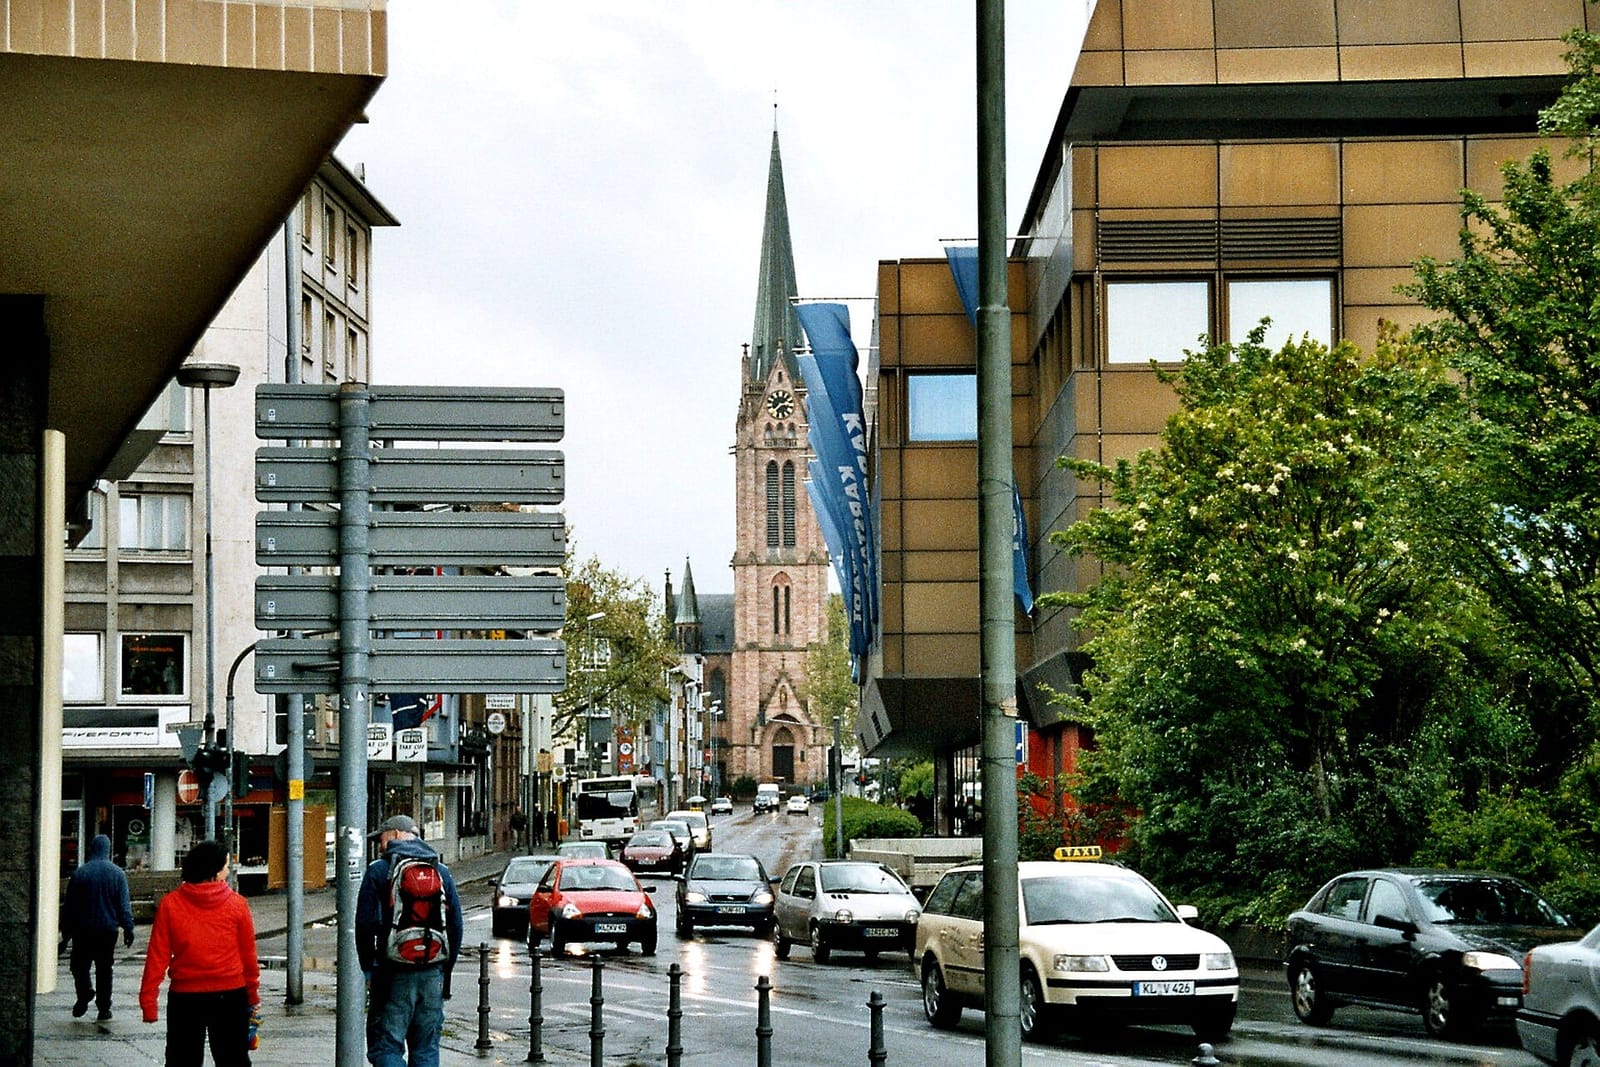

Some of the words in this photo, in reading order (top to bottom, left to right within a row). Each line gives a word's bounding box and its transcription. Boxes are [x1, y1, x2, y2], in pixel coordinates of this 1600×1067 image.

[1065, 848, 1096, 857] TAXI
[1142, 983, 1157, 994] KL
[1163, 983, 1171, 994] V
[1172, 983, 1191, 994] 426
